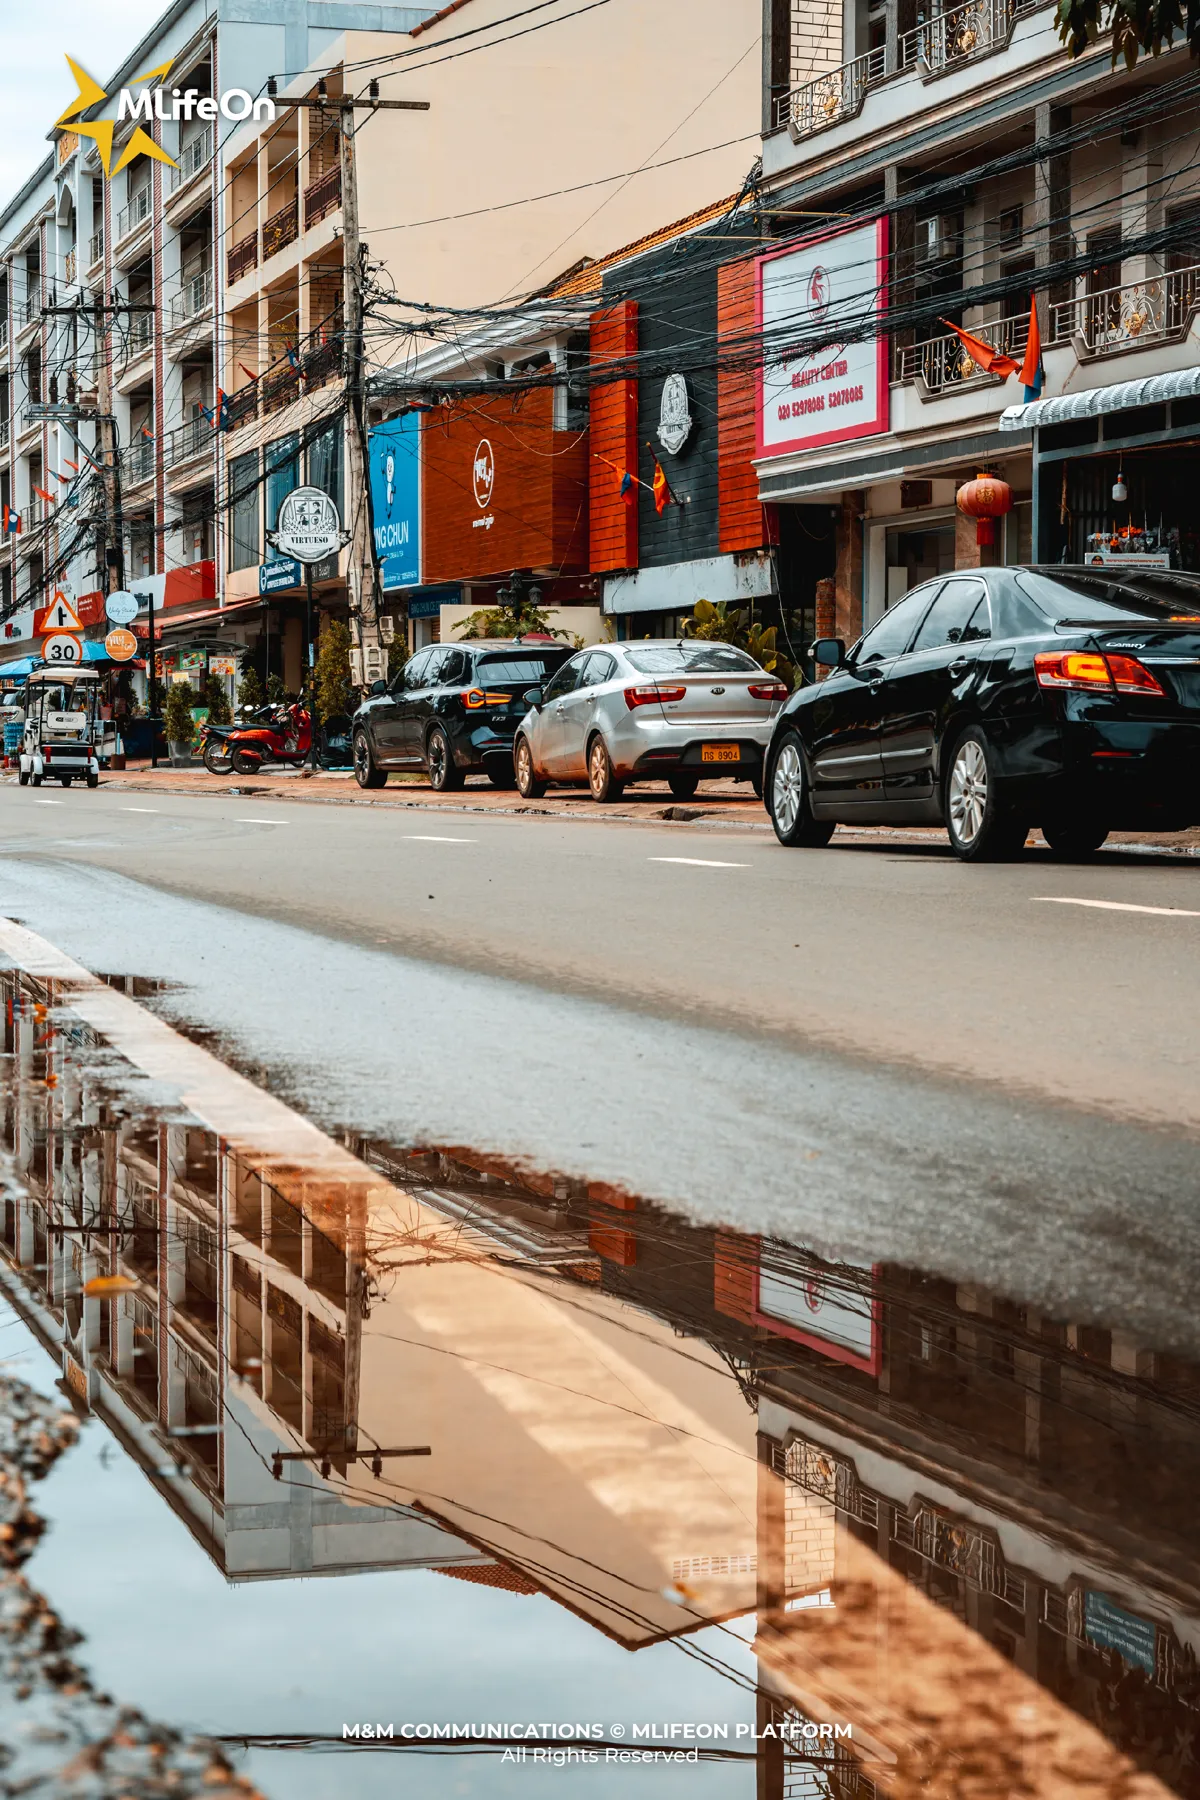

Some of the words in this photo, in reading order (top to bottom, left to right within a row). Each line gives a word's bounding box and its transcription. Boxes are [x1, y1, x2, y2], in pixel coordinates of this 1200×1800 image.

[792, 367, 819, 388] BEAUTY
[821, 360, 848, 380] CENTER
[778, 404, 790, 420] 020
[792, 395, 825, 417] 52978085
[976, 487, 995, 505] 福
[291, 536, 328, 544] VIRTUESO
[387, 520, 408, 547] CHUN
[51, 645, 74, 659] 30
[718, 751, 738, 760] 8904
